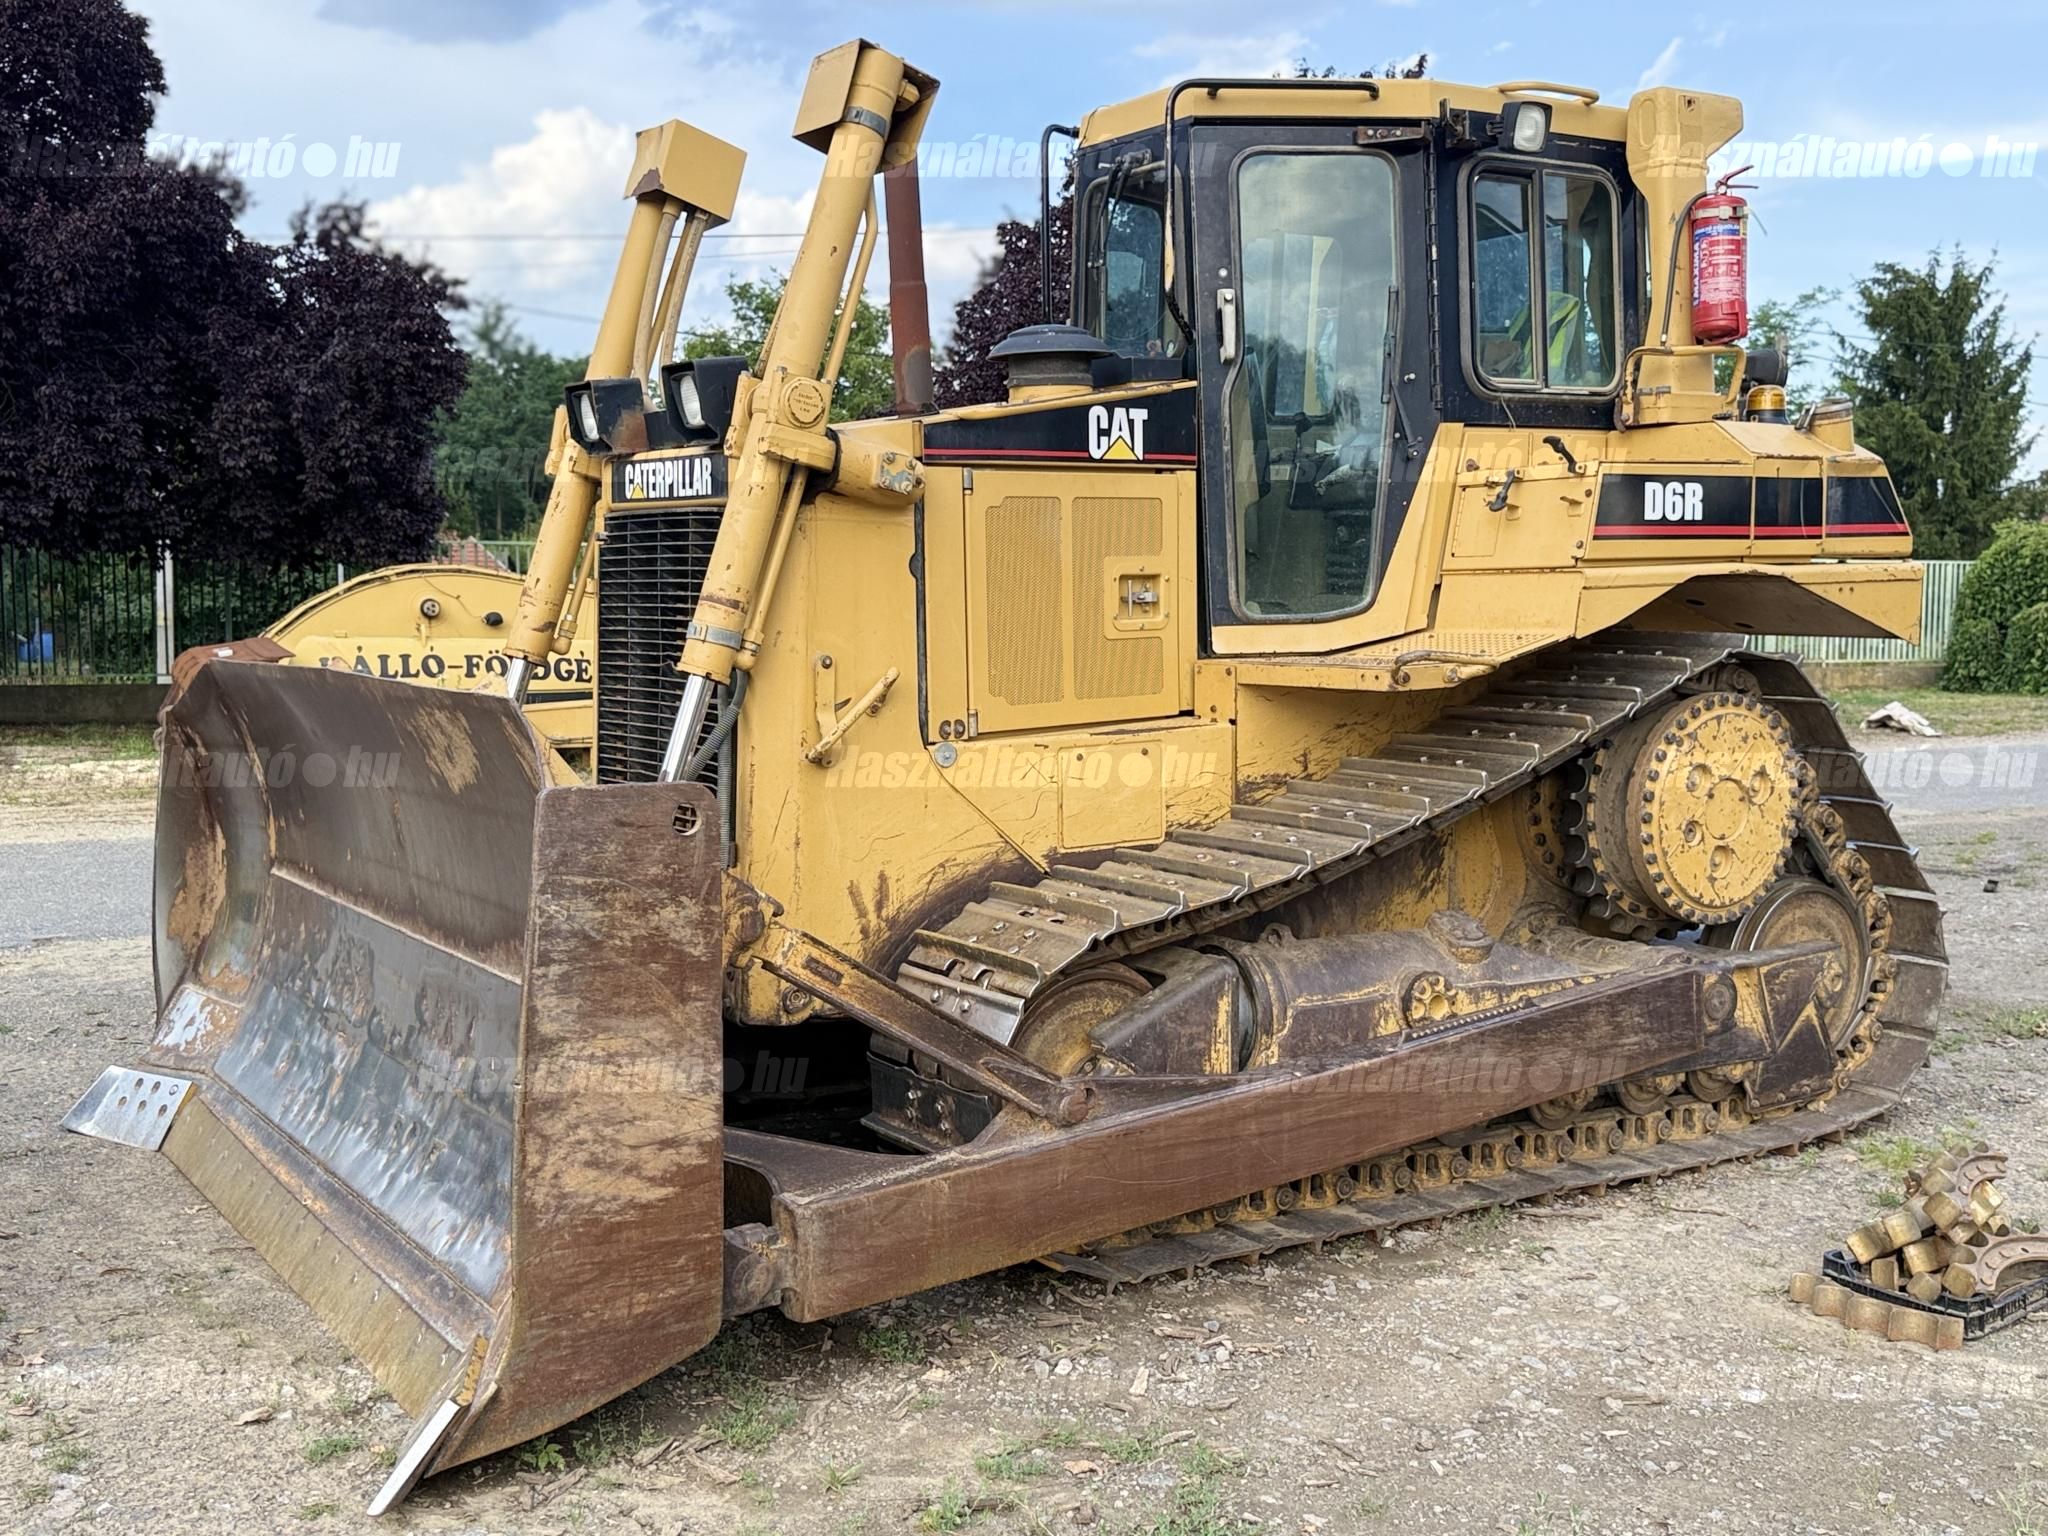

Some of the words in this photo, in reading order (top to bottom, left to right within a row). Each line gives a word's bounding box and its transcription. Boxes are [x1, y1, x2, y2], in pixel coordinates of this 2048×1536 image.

[1088, 405, 1148, 461] CAT
[625, 457, 712, 499] CATERPILLAR
[1644, 481, 1703, 521] D6R
